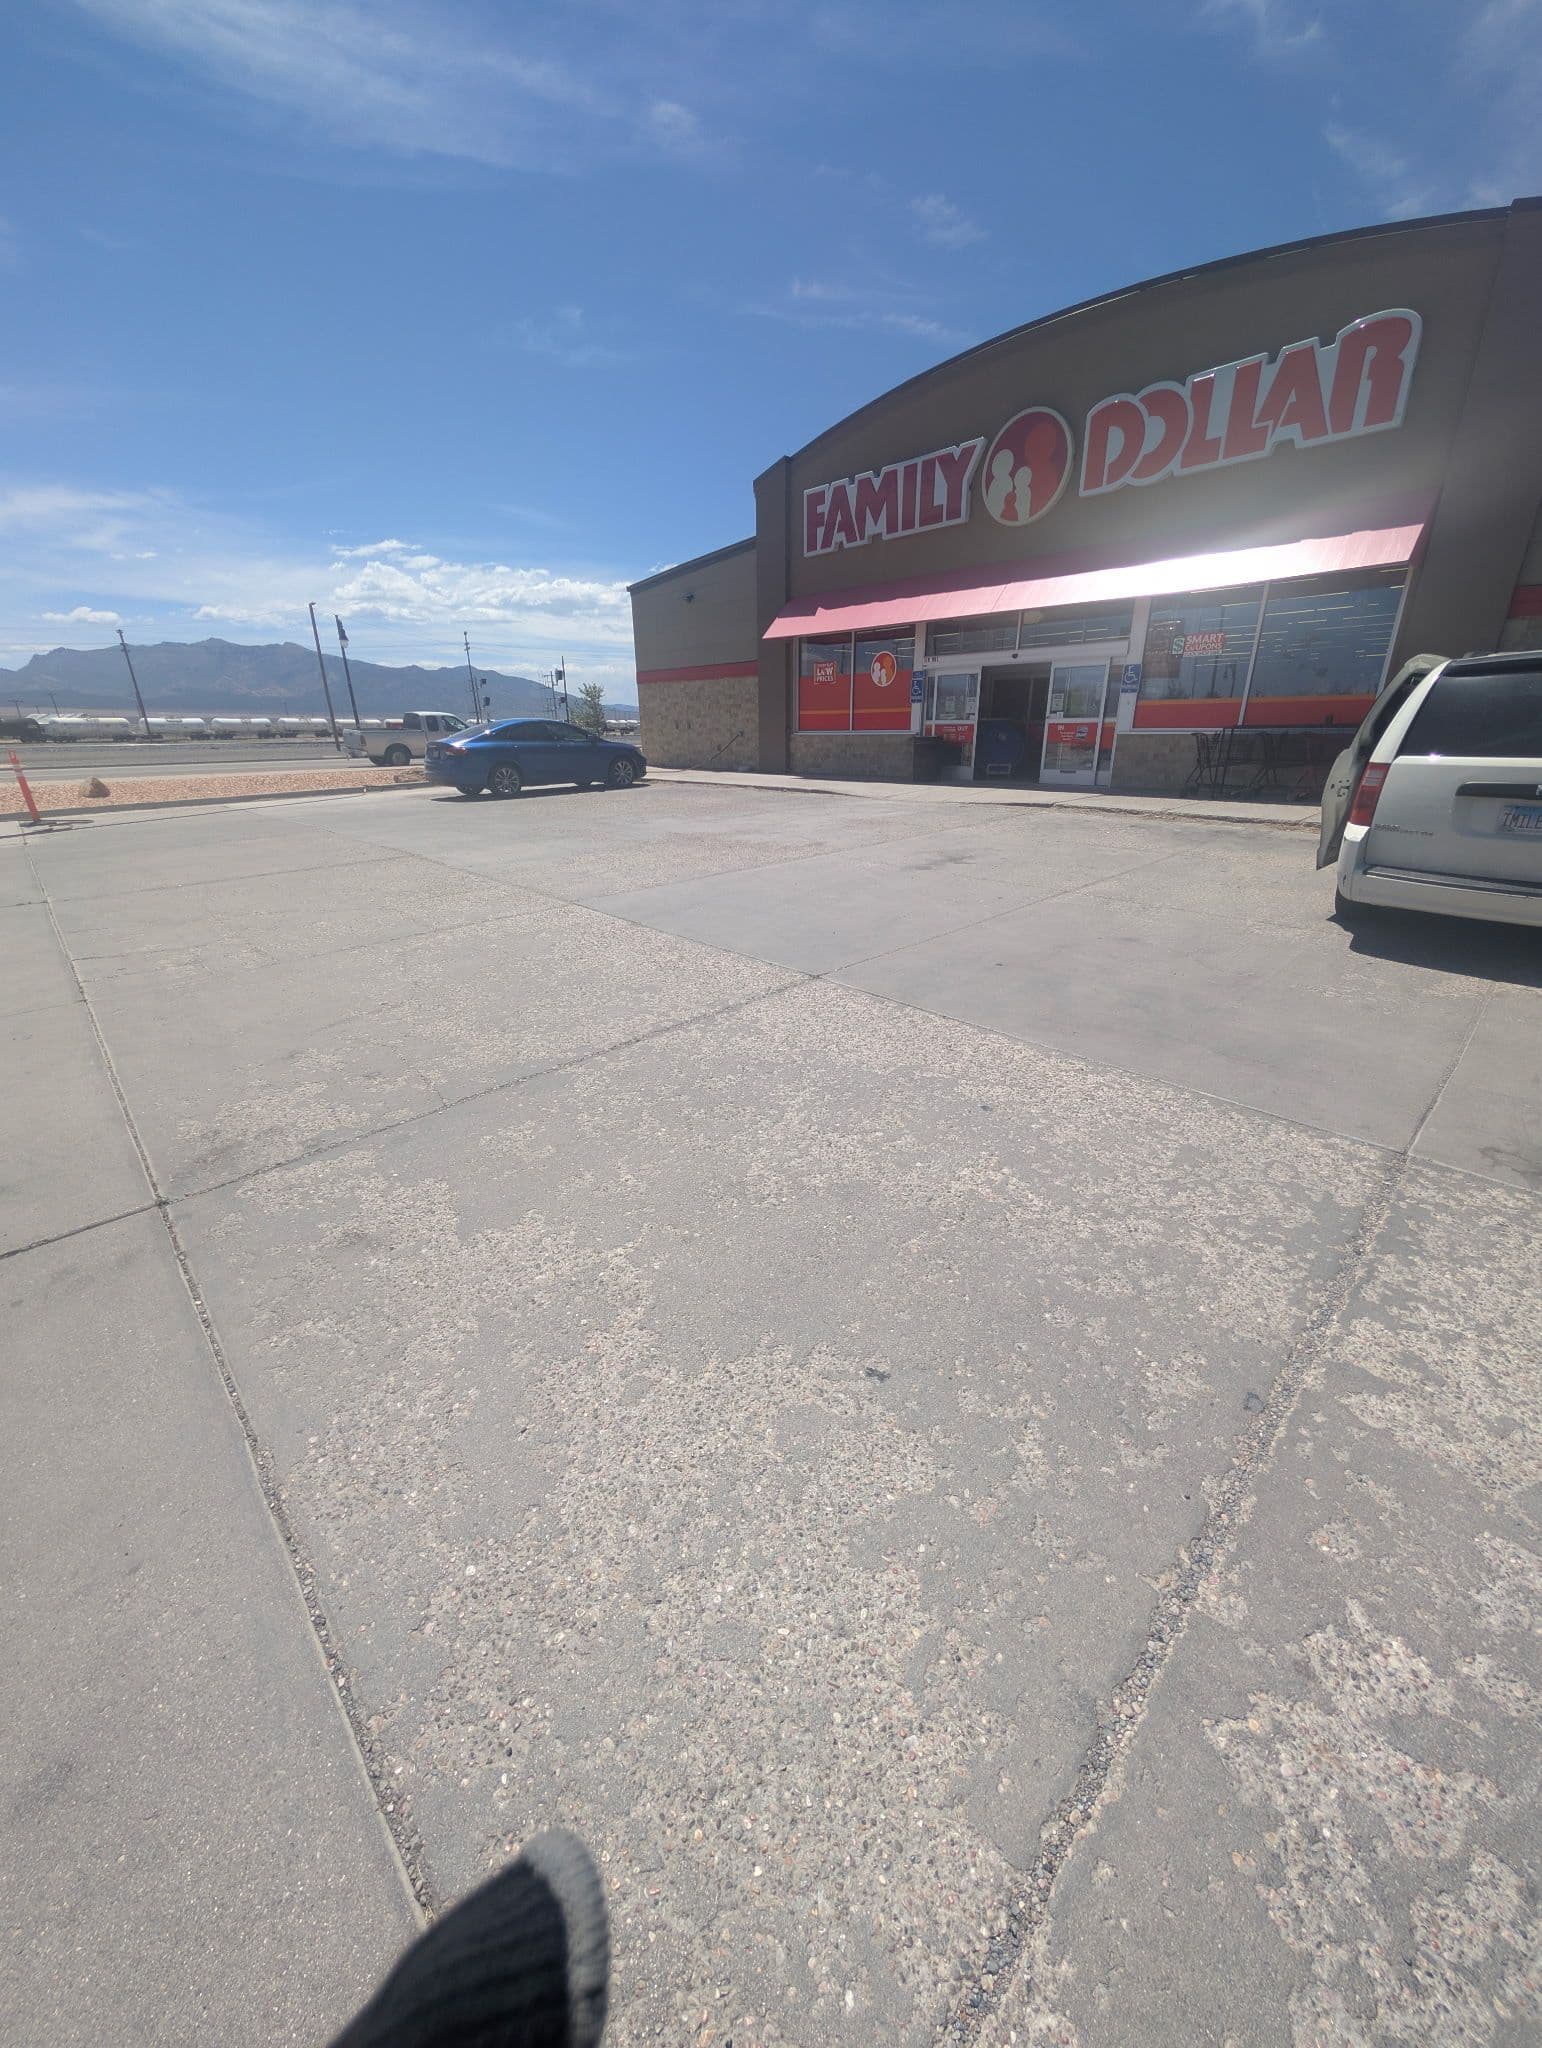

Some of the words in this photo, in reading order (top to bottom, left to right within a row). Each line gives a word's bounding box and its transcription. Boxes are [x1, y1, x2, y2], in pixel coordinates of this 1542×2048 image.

[805, 438, 982, 556] FAMILY
[1081, 311, 1419, 495] DOLLAR
[1186, 633, 1224, 645] SMART
